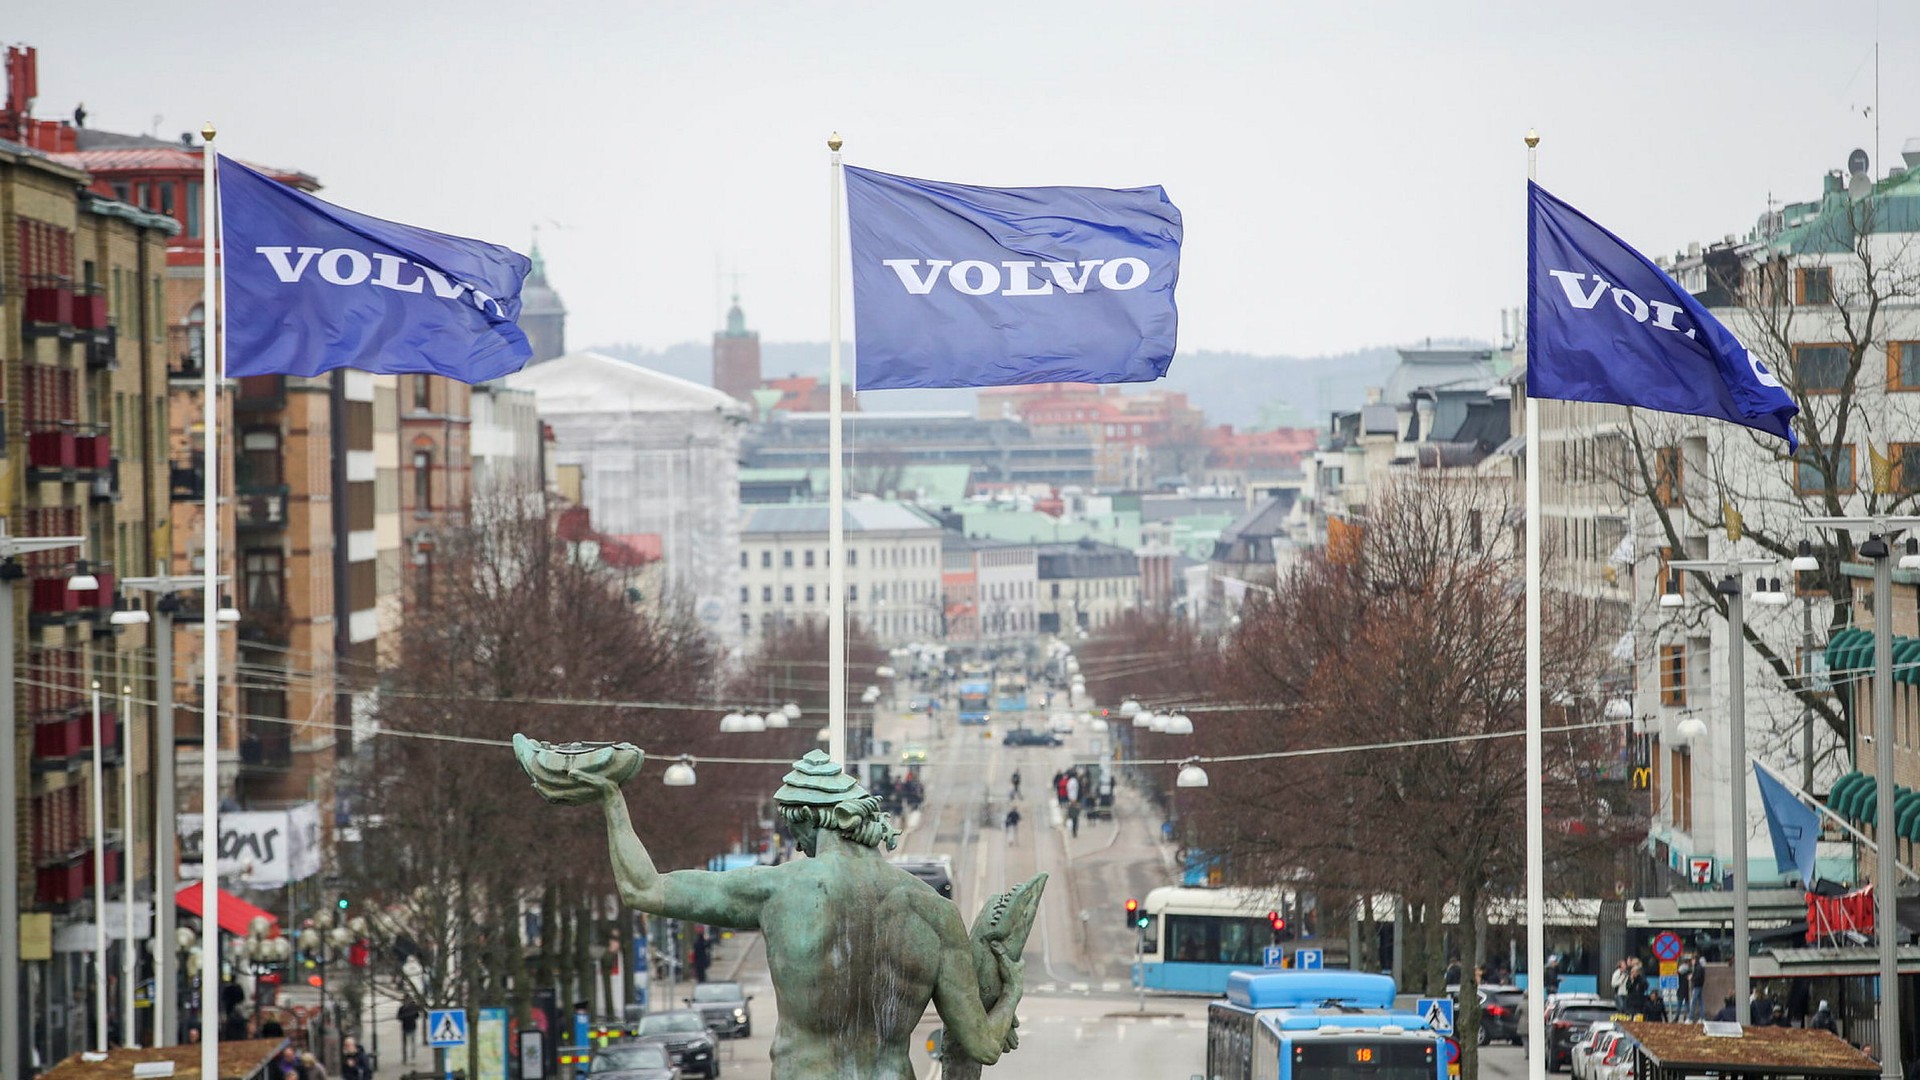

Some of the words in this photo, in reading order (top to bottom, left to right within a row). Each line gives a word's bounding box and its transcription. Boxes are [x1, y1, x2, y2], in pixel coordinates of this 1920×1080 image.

[882, 257, 1150, 296] VOLVO
[1693, 862, 1710, 884] 7
[1269, 949, 1279, 964] P
[1303, 951, 1317, 970] P
[1356, 1048, 1372, 1062] 18
